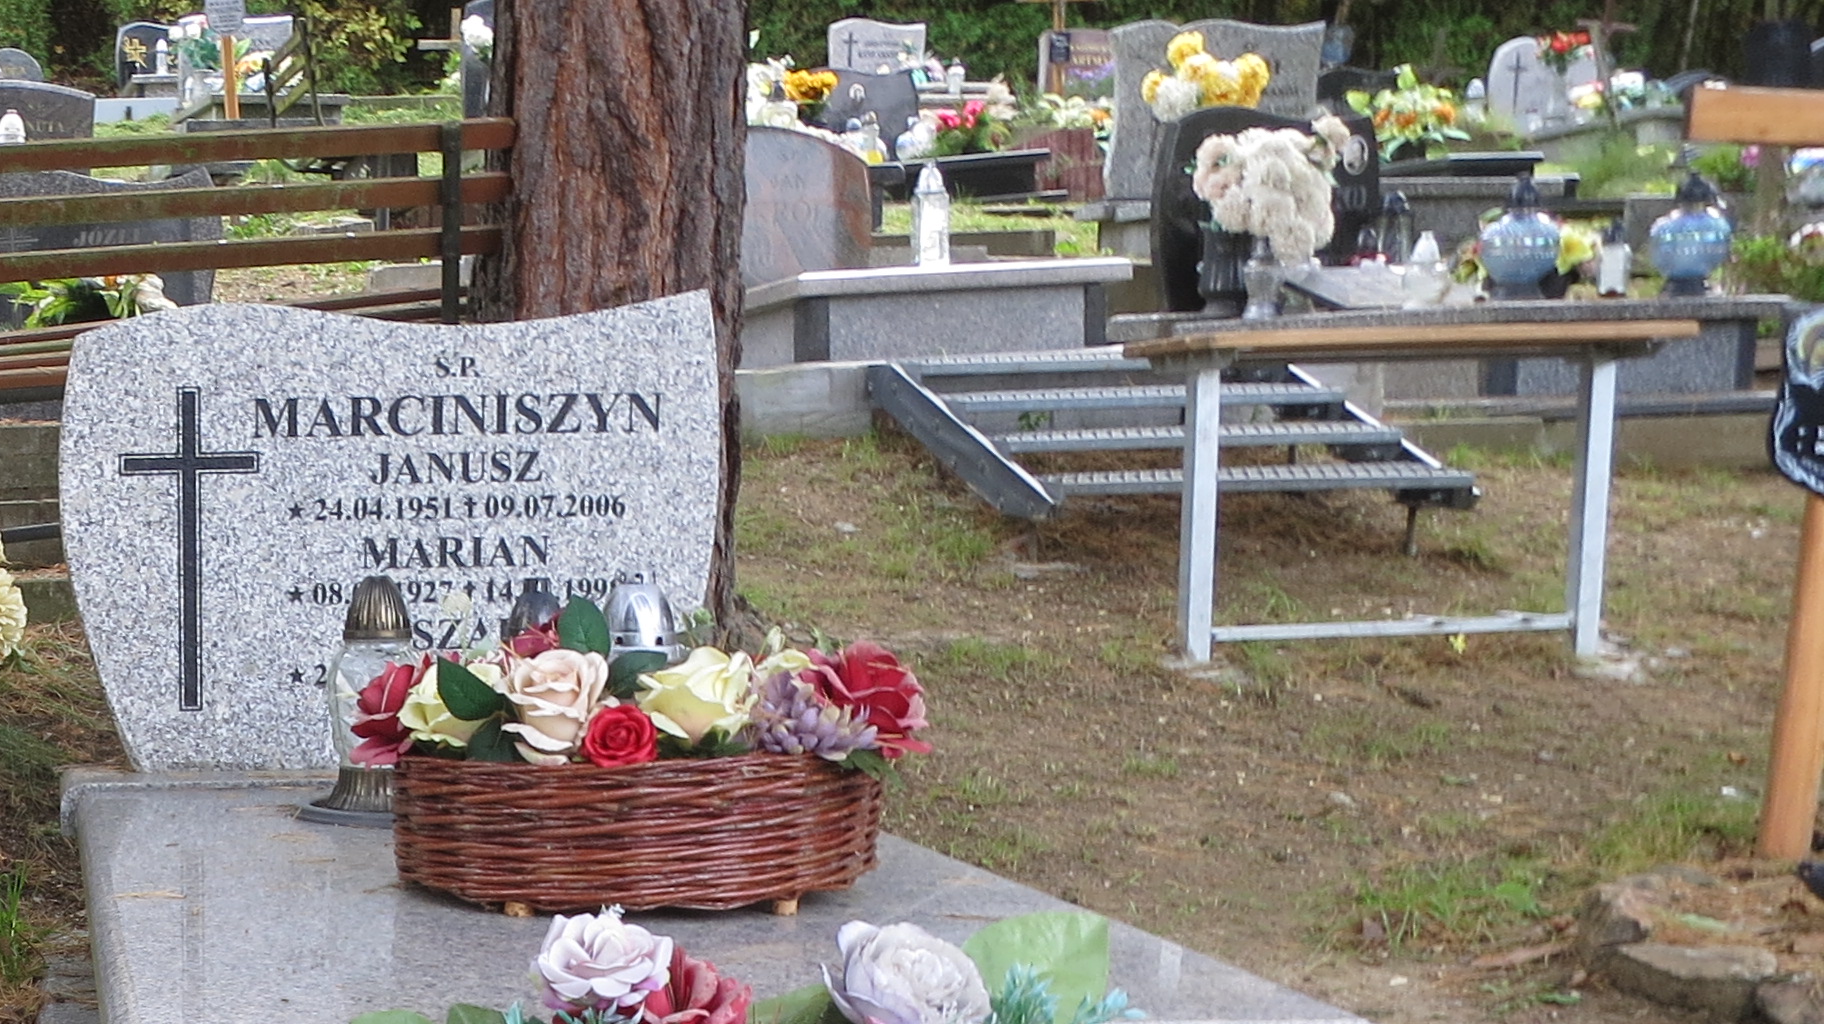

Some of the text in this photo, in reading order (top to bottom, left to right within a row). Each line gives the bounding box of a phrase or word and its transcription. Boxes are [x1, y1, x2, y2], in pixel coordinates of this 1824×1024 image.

[252, 391, 663, 438] MARCINISZYN
[371, 450, 544, 484] JANUSZ
[314, 493, 628, 521] 24.04.1951 09.07.2006
[362, 535, 550, 570] MARIAN
